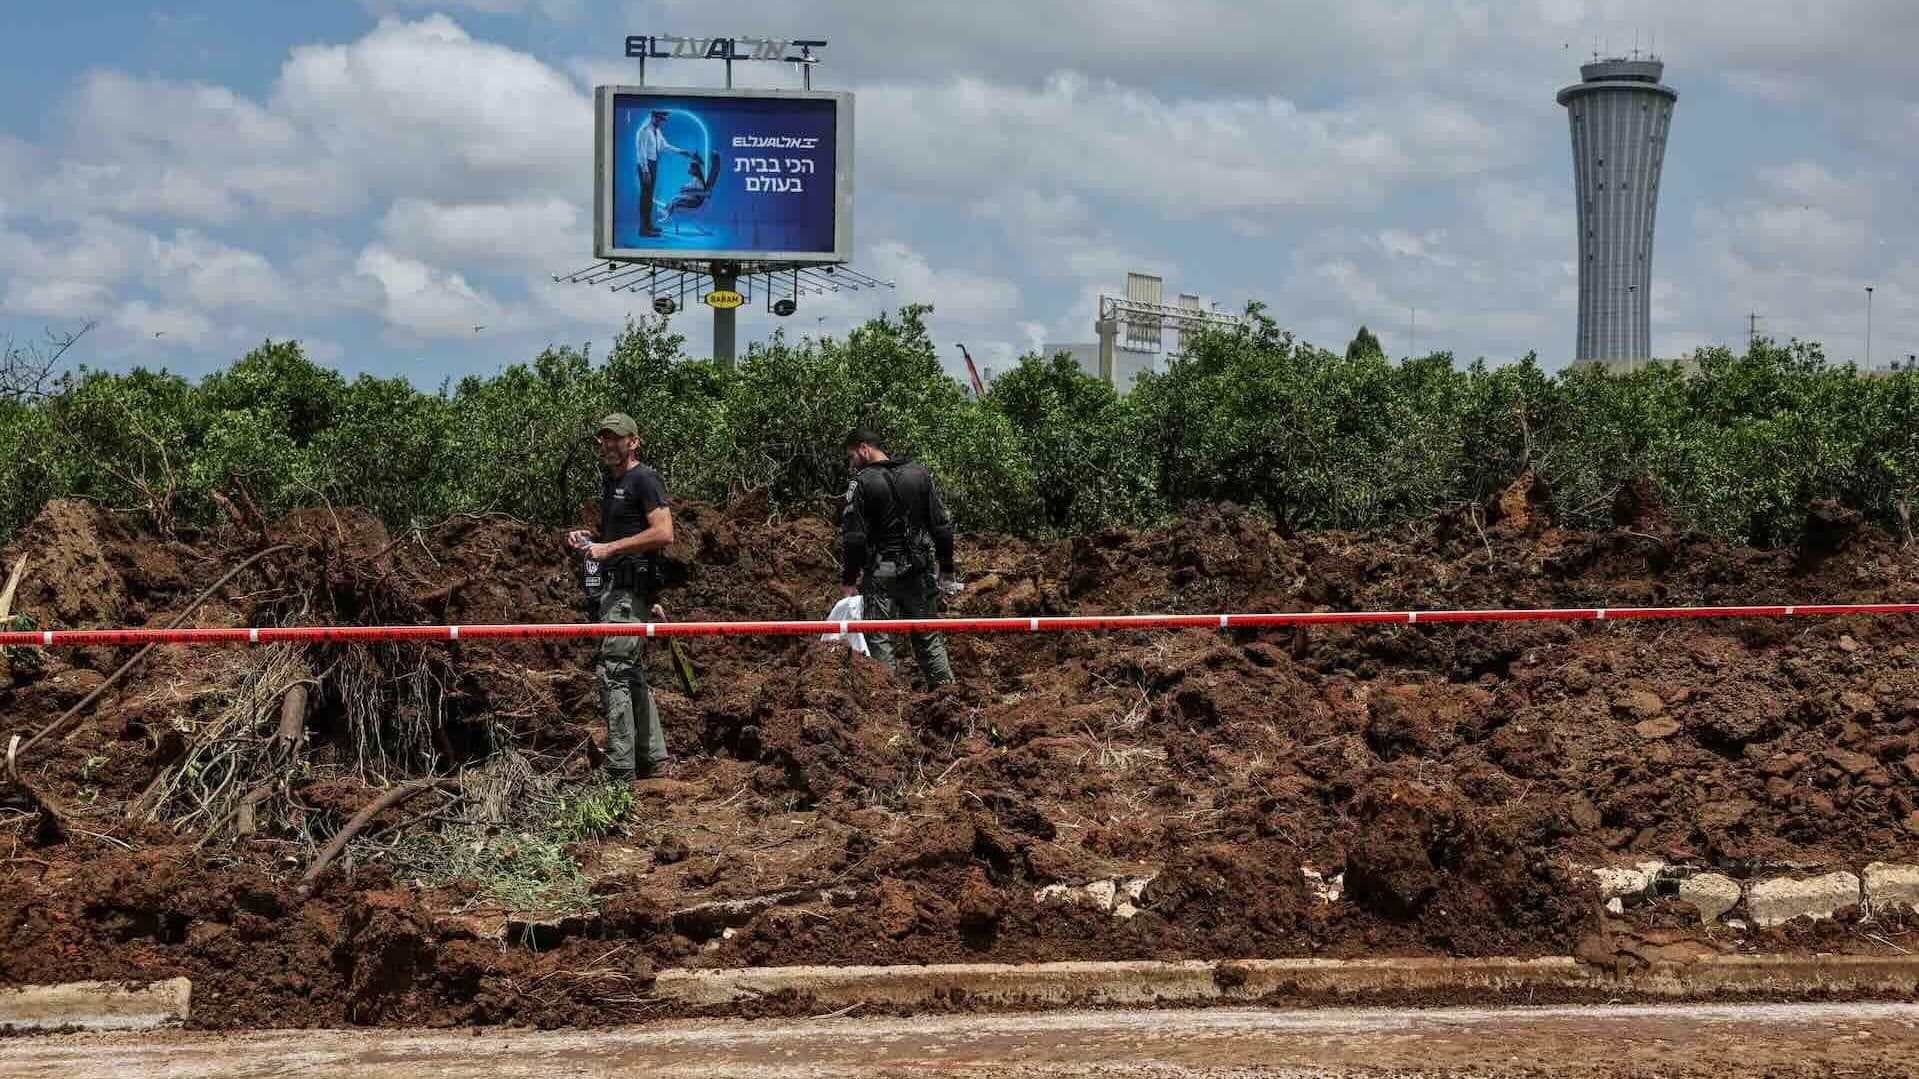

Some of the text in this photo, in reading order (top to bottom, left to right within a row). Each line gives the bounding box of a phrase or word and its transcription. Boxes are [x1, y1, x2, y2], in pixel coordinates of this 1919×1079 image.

[733, 157, 815, 174] הכי בבית
[744, 175, 804, 193] בעולם
